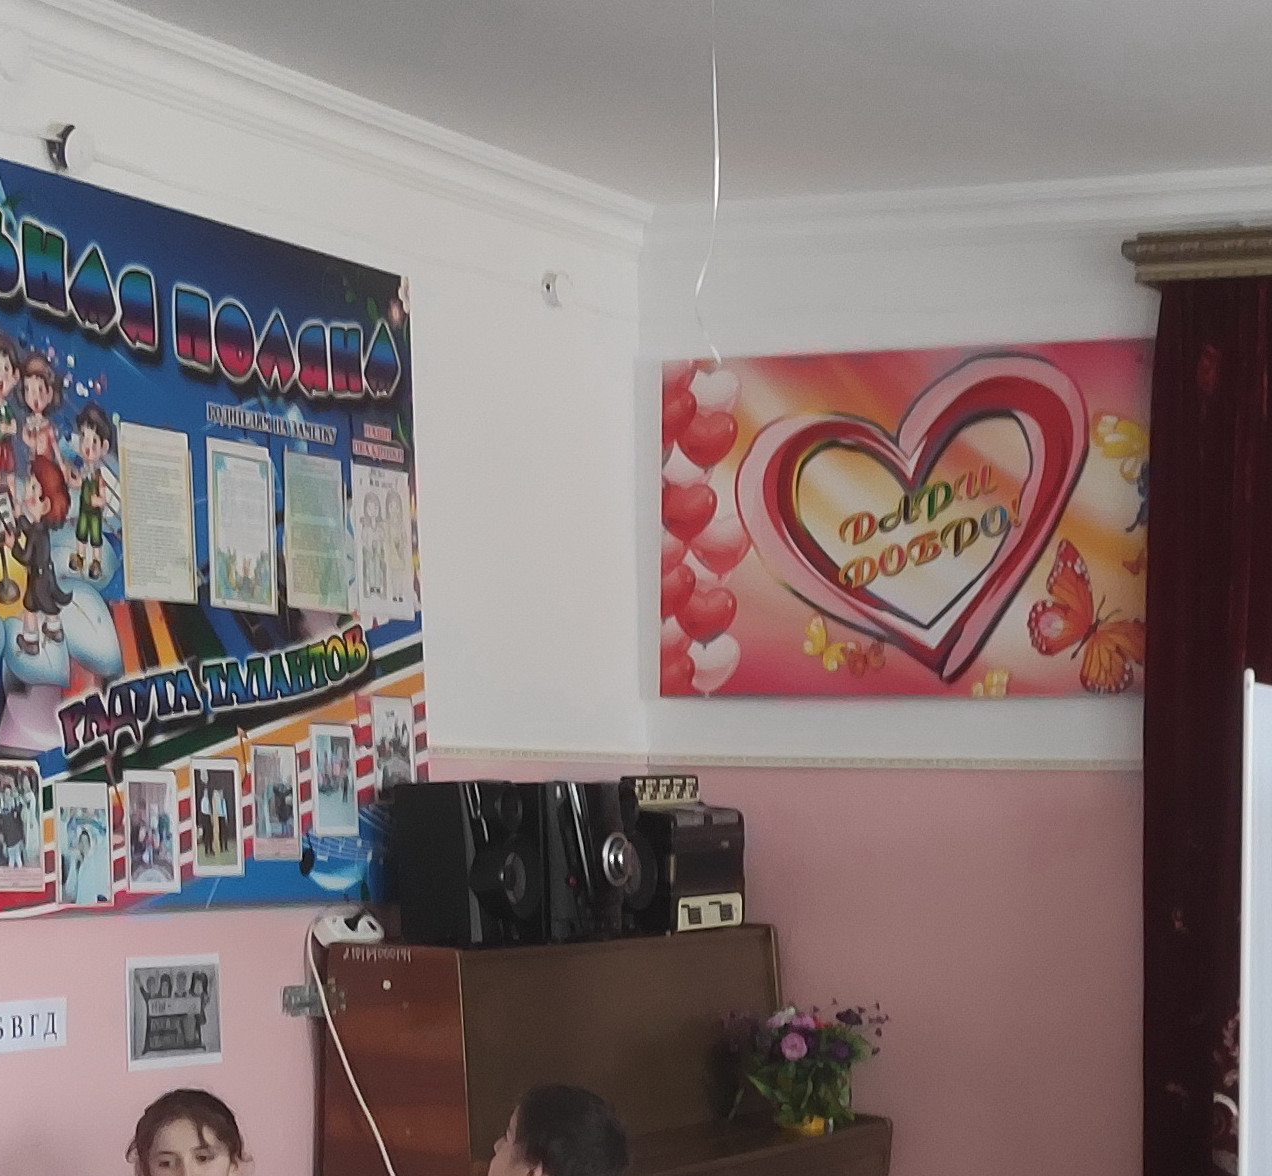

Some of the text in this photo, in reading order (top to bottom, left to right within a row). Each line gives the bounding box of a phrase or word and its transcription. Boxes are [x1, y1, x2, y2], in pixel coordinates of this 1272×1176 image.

[173, 283, 402, 399] ПОЛЯНА
[838, 465, 998, 546] ДАРИ
[57, 624, 369, 756] РАДУГА ТАЛАНТОВ
